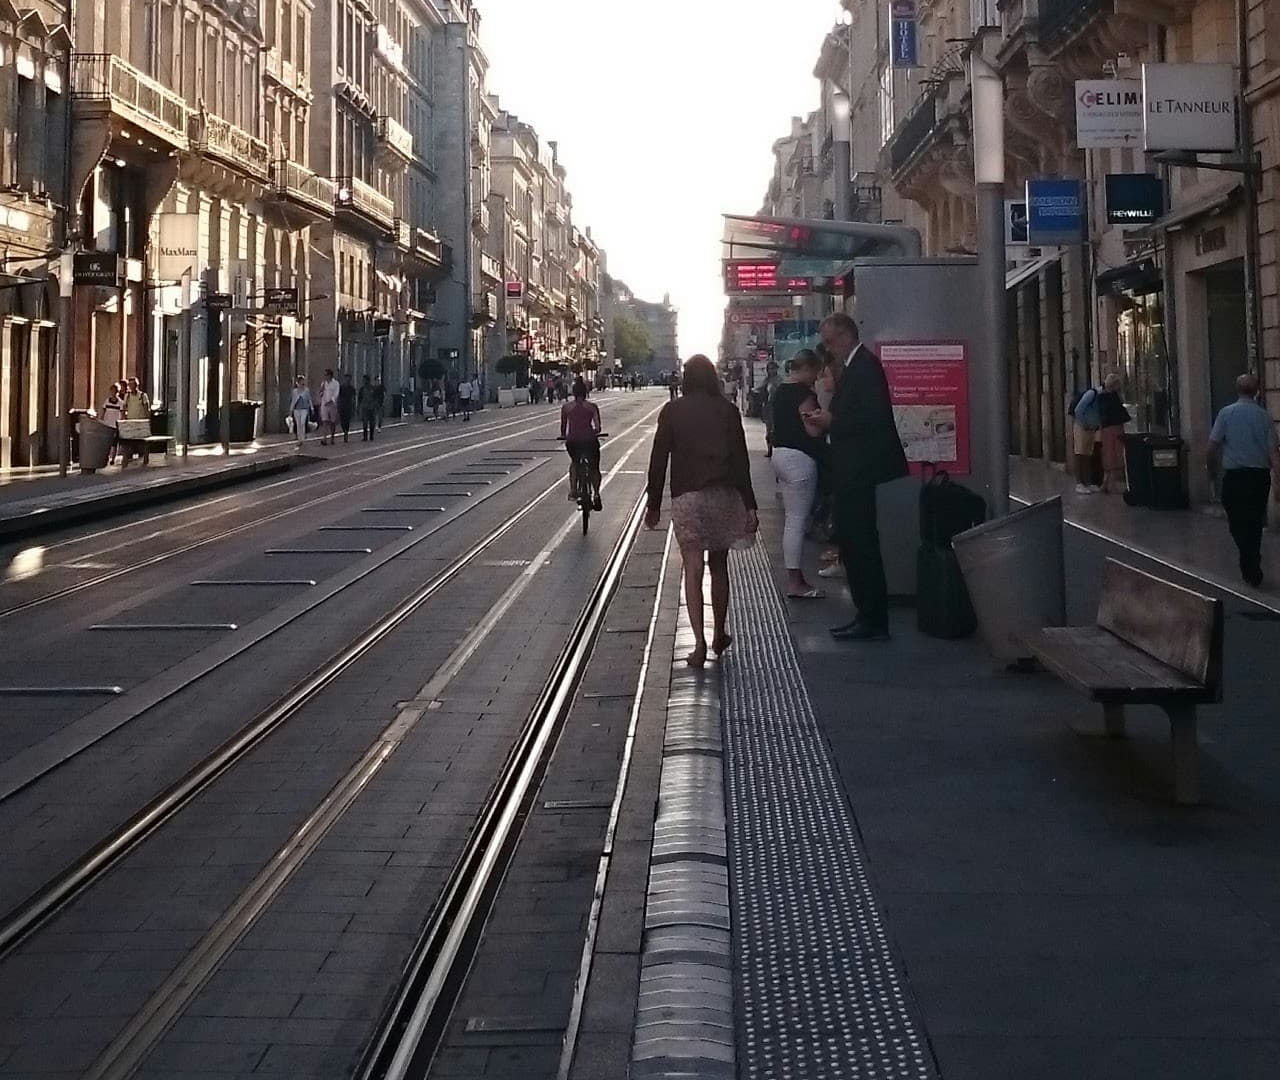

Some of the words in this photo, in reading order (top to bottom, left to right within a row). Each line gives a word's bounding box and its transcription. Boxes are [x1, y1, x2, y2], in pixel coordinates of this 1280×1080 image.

[1081, 90, 1143, 107] CELIM
[1149, 101, 1163, 114] LE
[1164, 99, 1231, 114] TANNEUR
[160, 248, 197, 257] MaxMara
